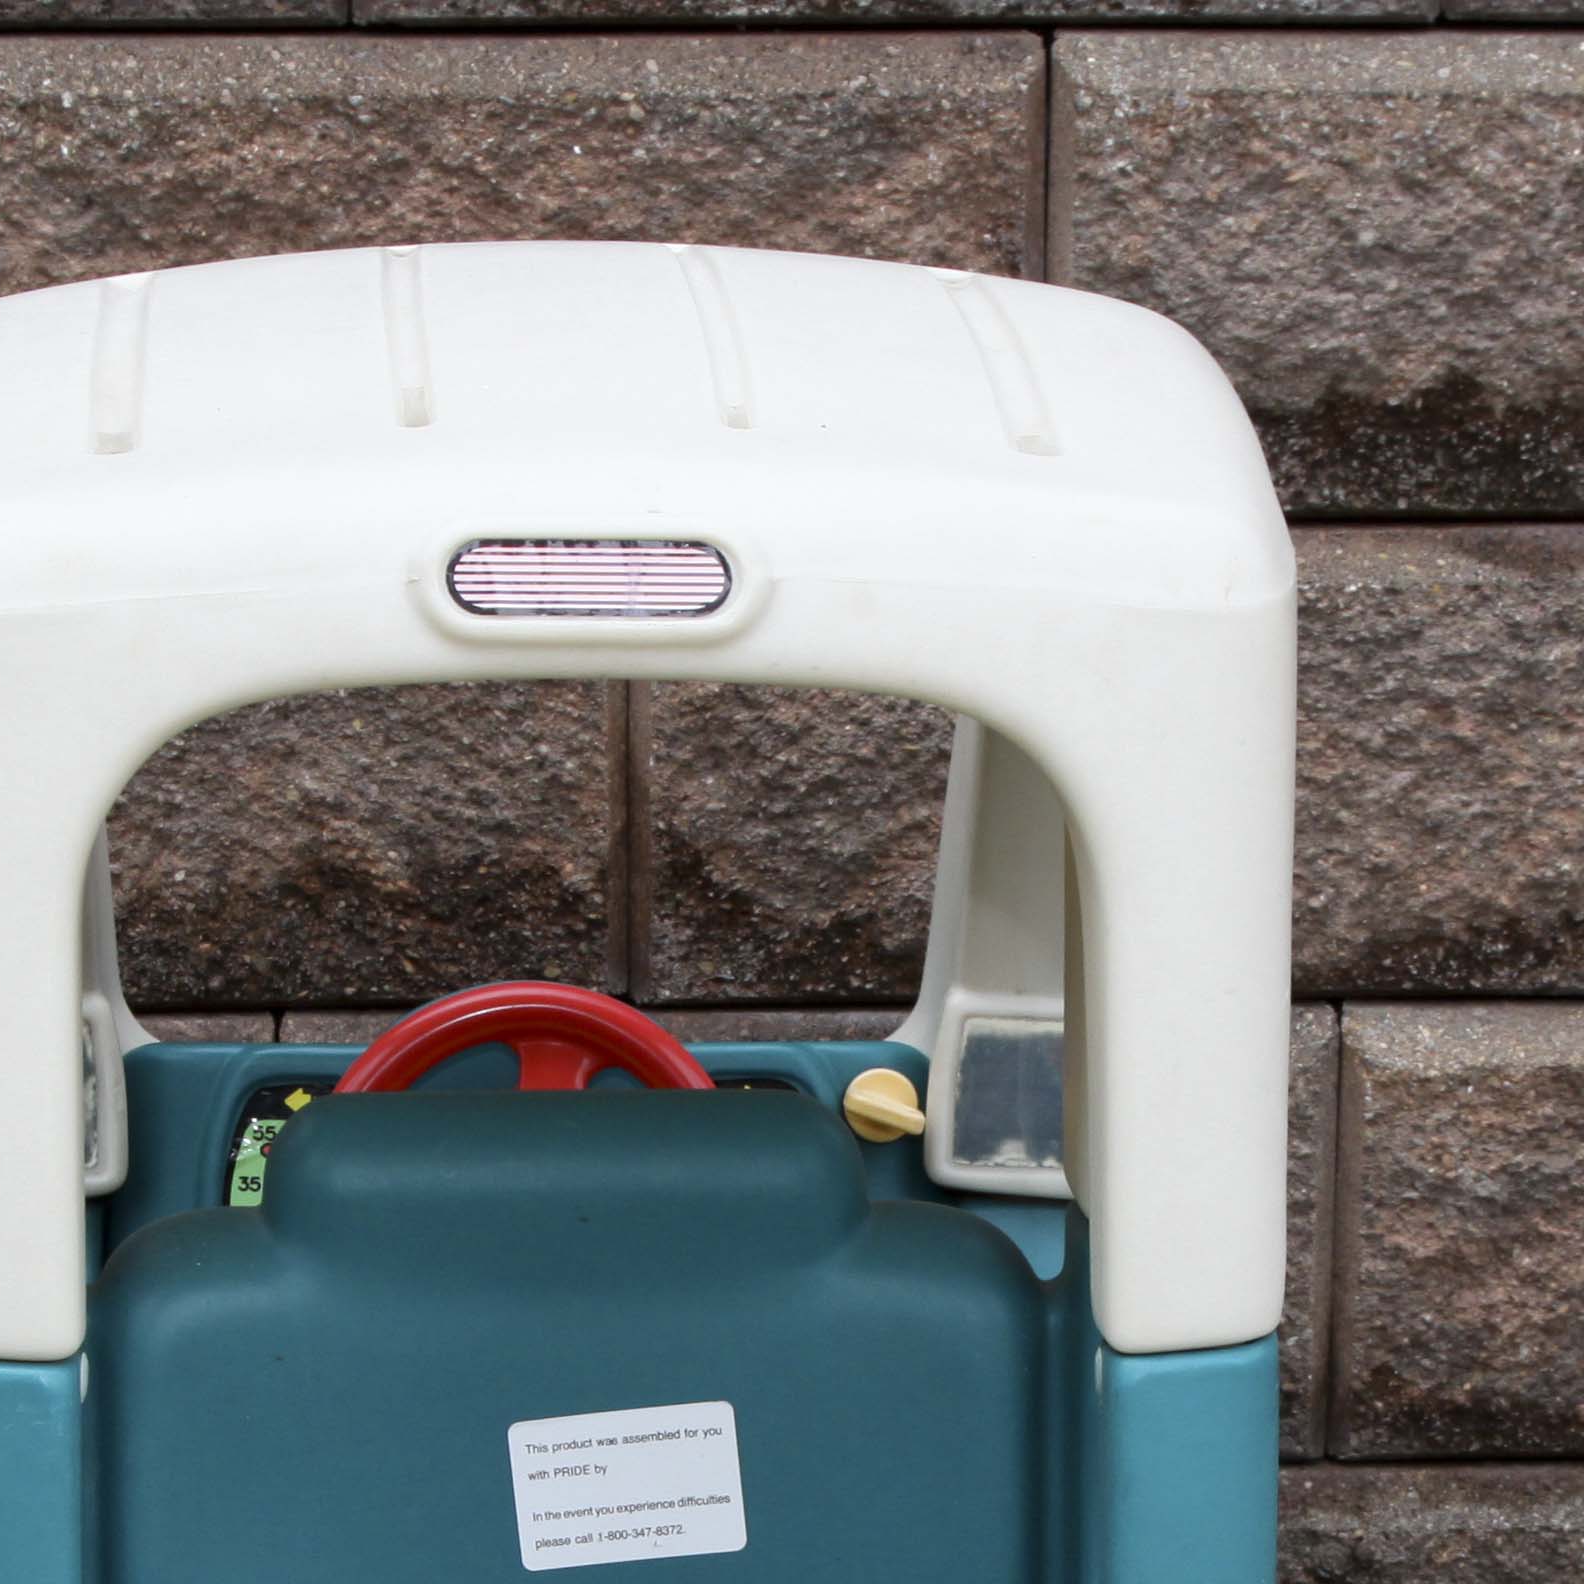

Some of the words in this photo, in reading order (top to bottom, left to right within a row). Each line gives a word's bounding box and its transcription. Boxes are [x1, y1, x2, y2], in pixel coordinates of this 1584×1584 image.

[238, 1176, 261, 1192] 35
[525, 1444, 549, 1454] This
[552, 1439, 592, 1453] product
[596, 1438, 618, 1447] was
[622, 1429, 681, 1444] assembled
[684, 1428, 699, 1438] for
[702, 1427, 722, 1438] you
[528, 1470, 550, 1480] with
[554, 1464, 591, 1478] PRIDE
[594, 1463, 608, 1476] by
[533, 1511, 543, 1522] In
[544, 1509, 562, 1520] the
[563, 1507, 593, 1518] event
[595, 1506, 615, 1517] you
[616, 1499, 676, 1514] experience
[677, 1494, 731, 1508] difficulties
[535, 1536, 572, 1551] please
[575, 1533, 594, 1544] call
